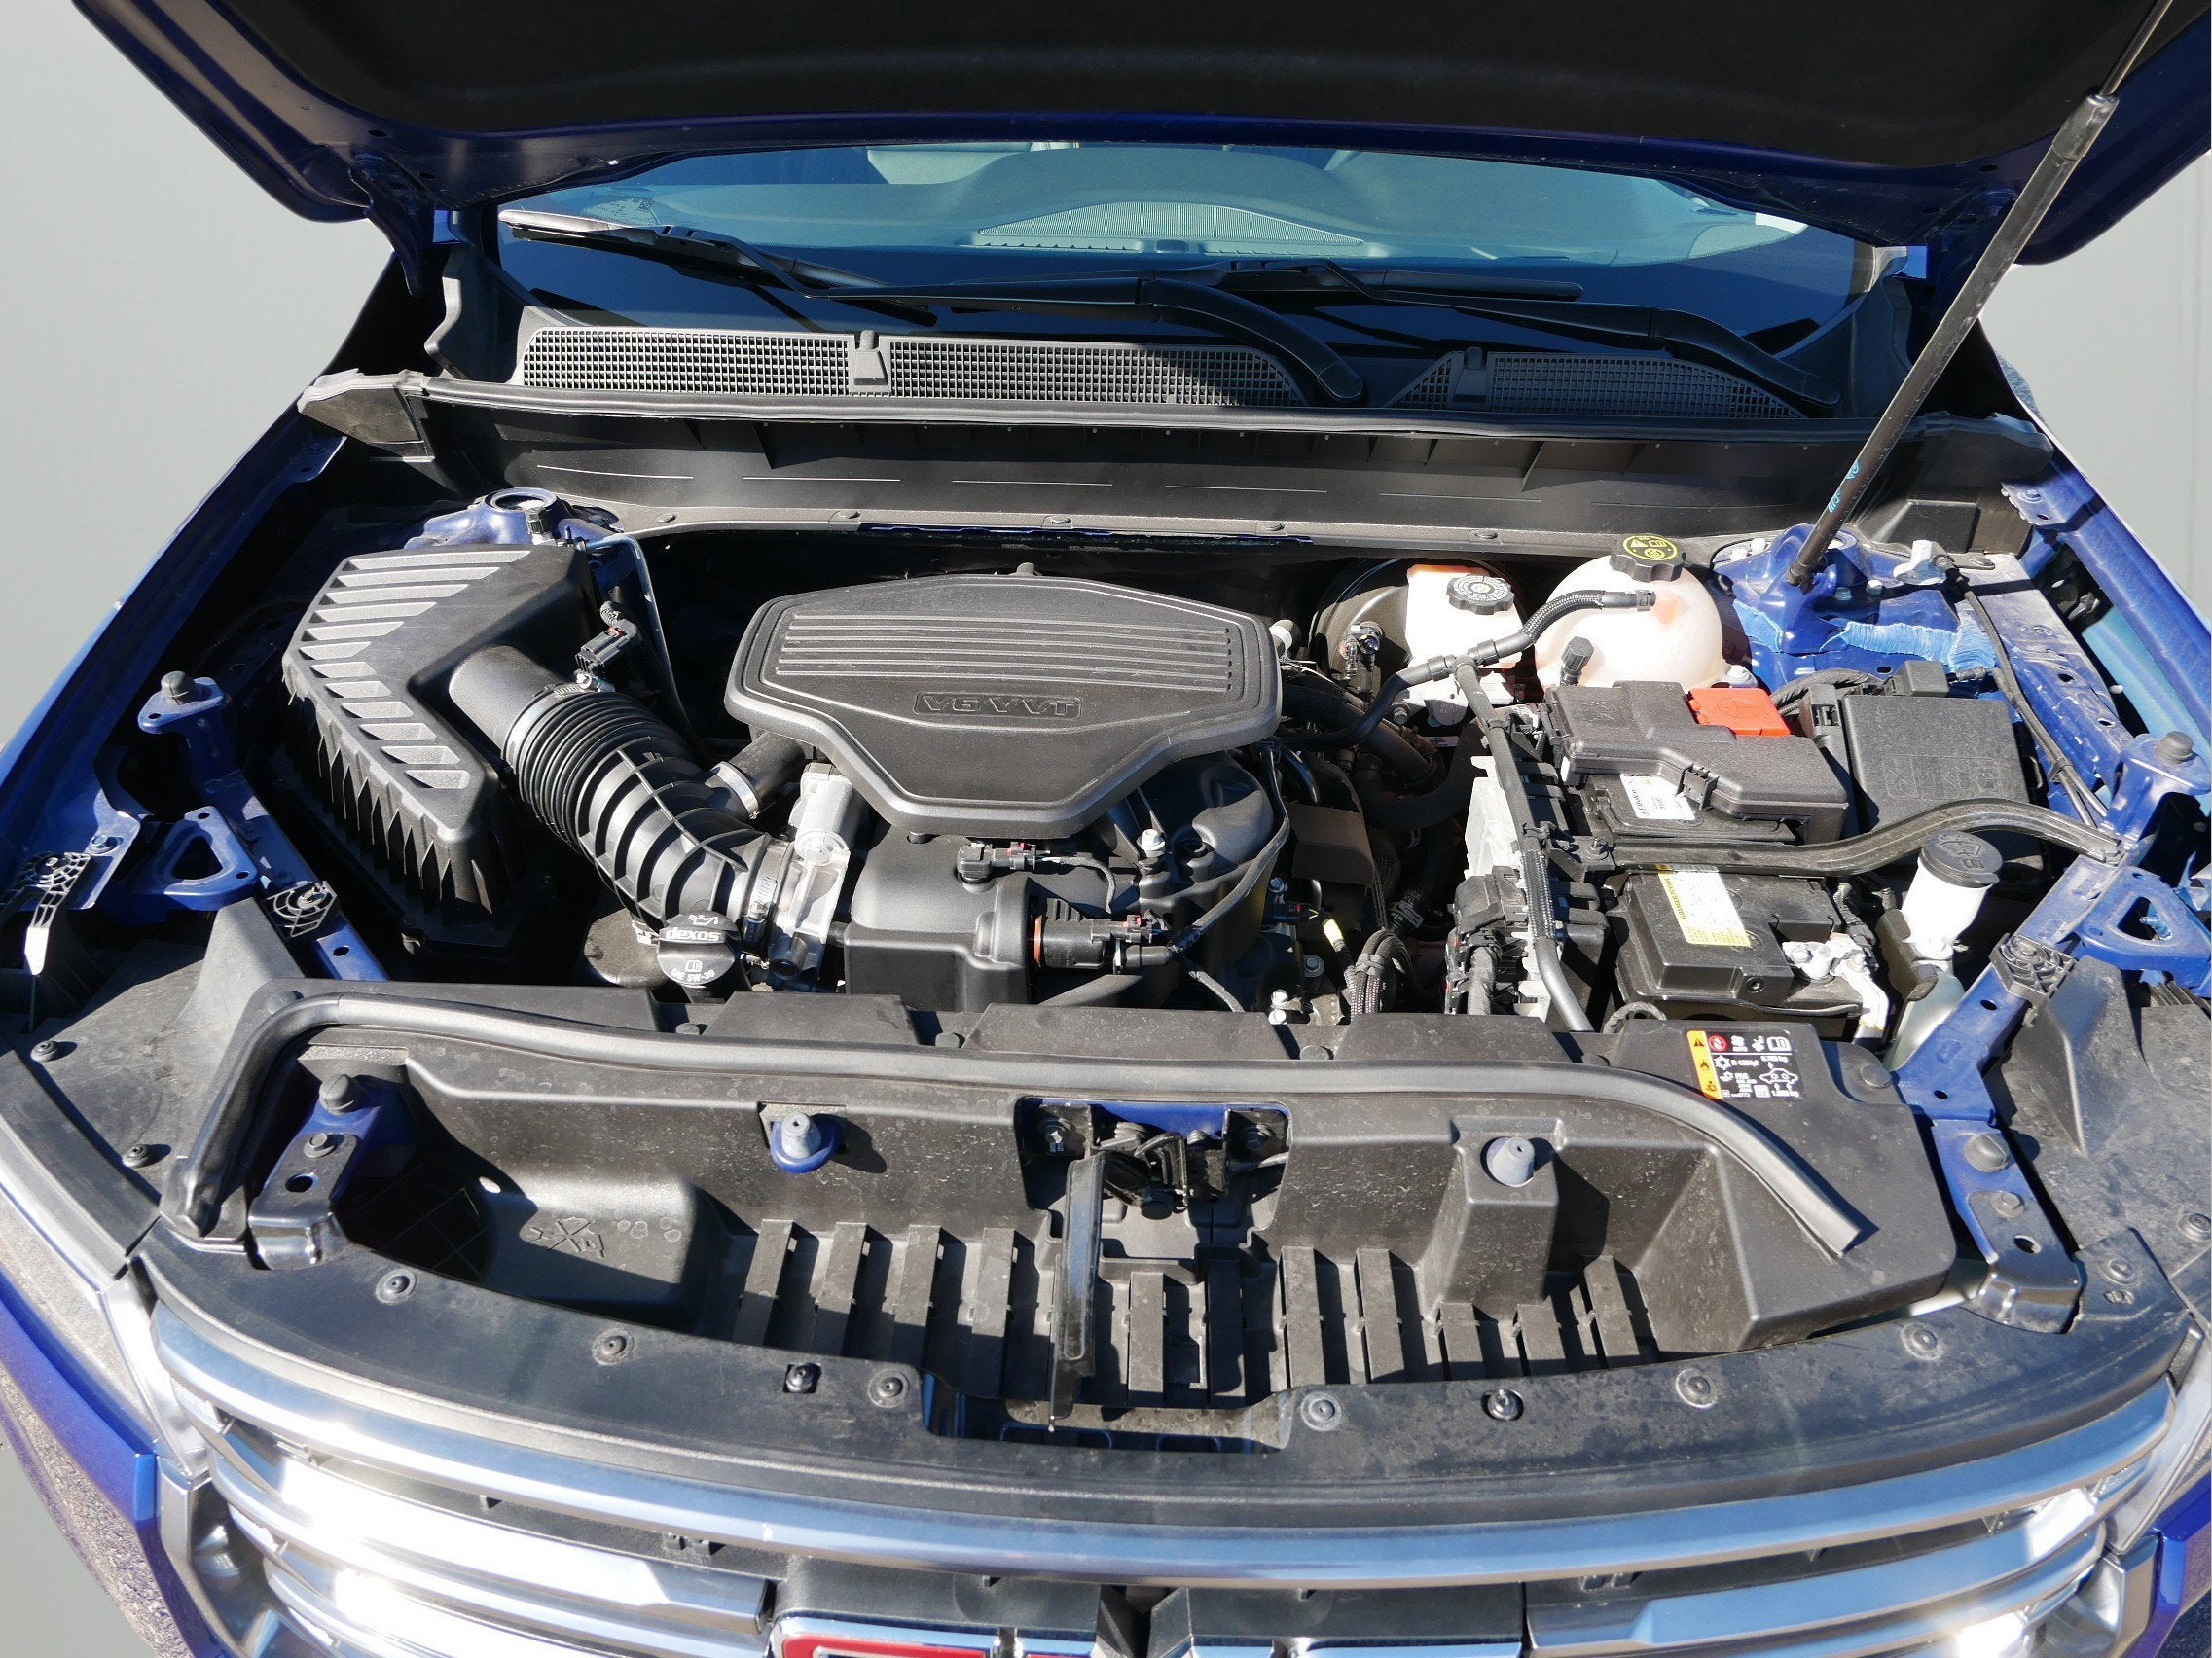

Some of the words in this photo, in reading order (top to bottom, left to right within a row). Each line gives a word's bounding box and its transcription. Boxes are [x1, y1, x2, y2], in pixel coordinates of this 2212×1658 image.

[922, 695, 981, 711] V6
[989, 698, 1078, 716] VVT
[665, 927, 721, 942] dexos
